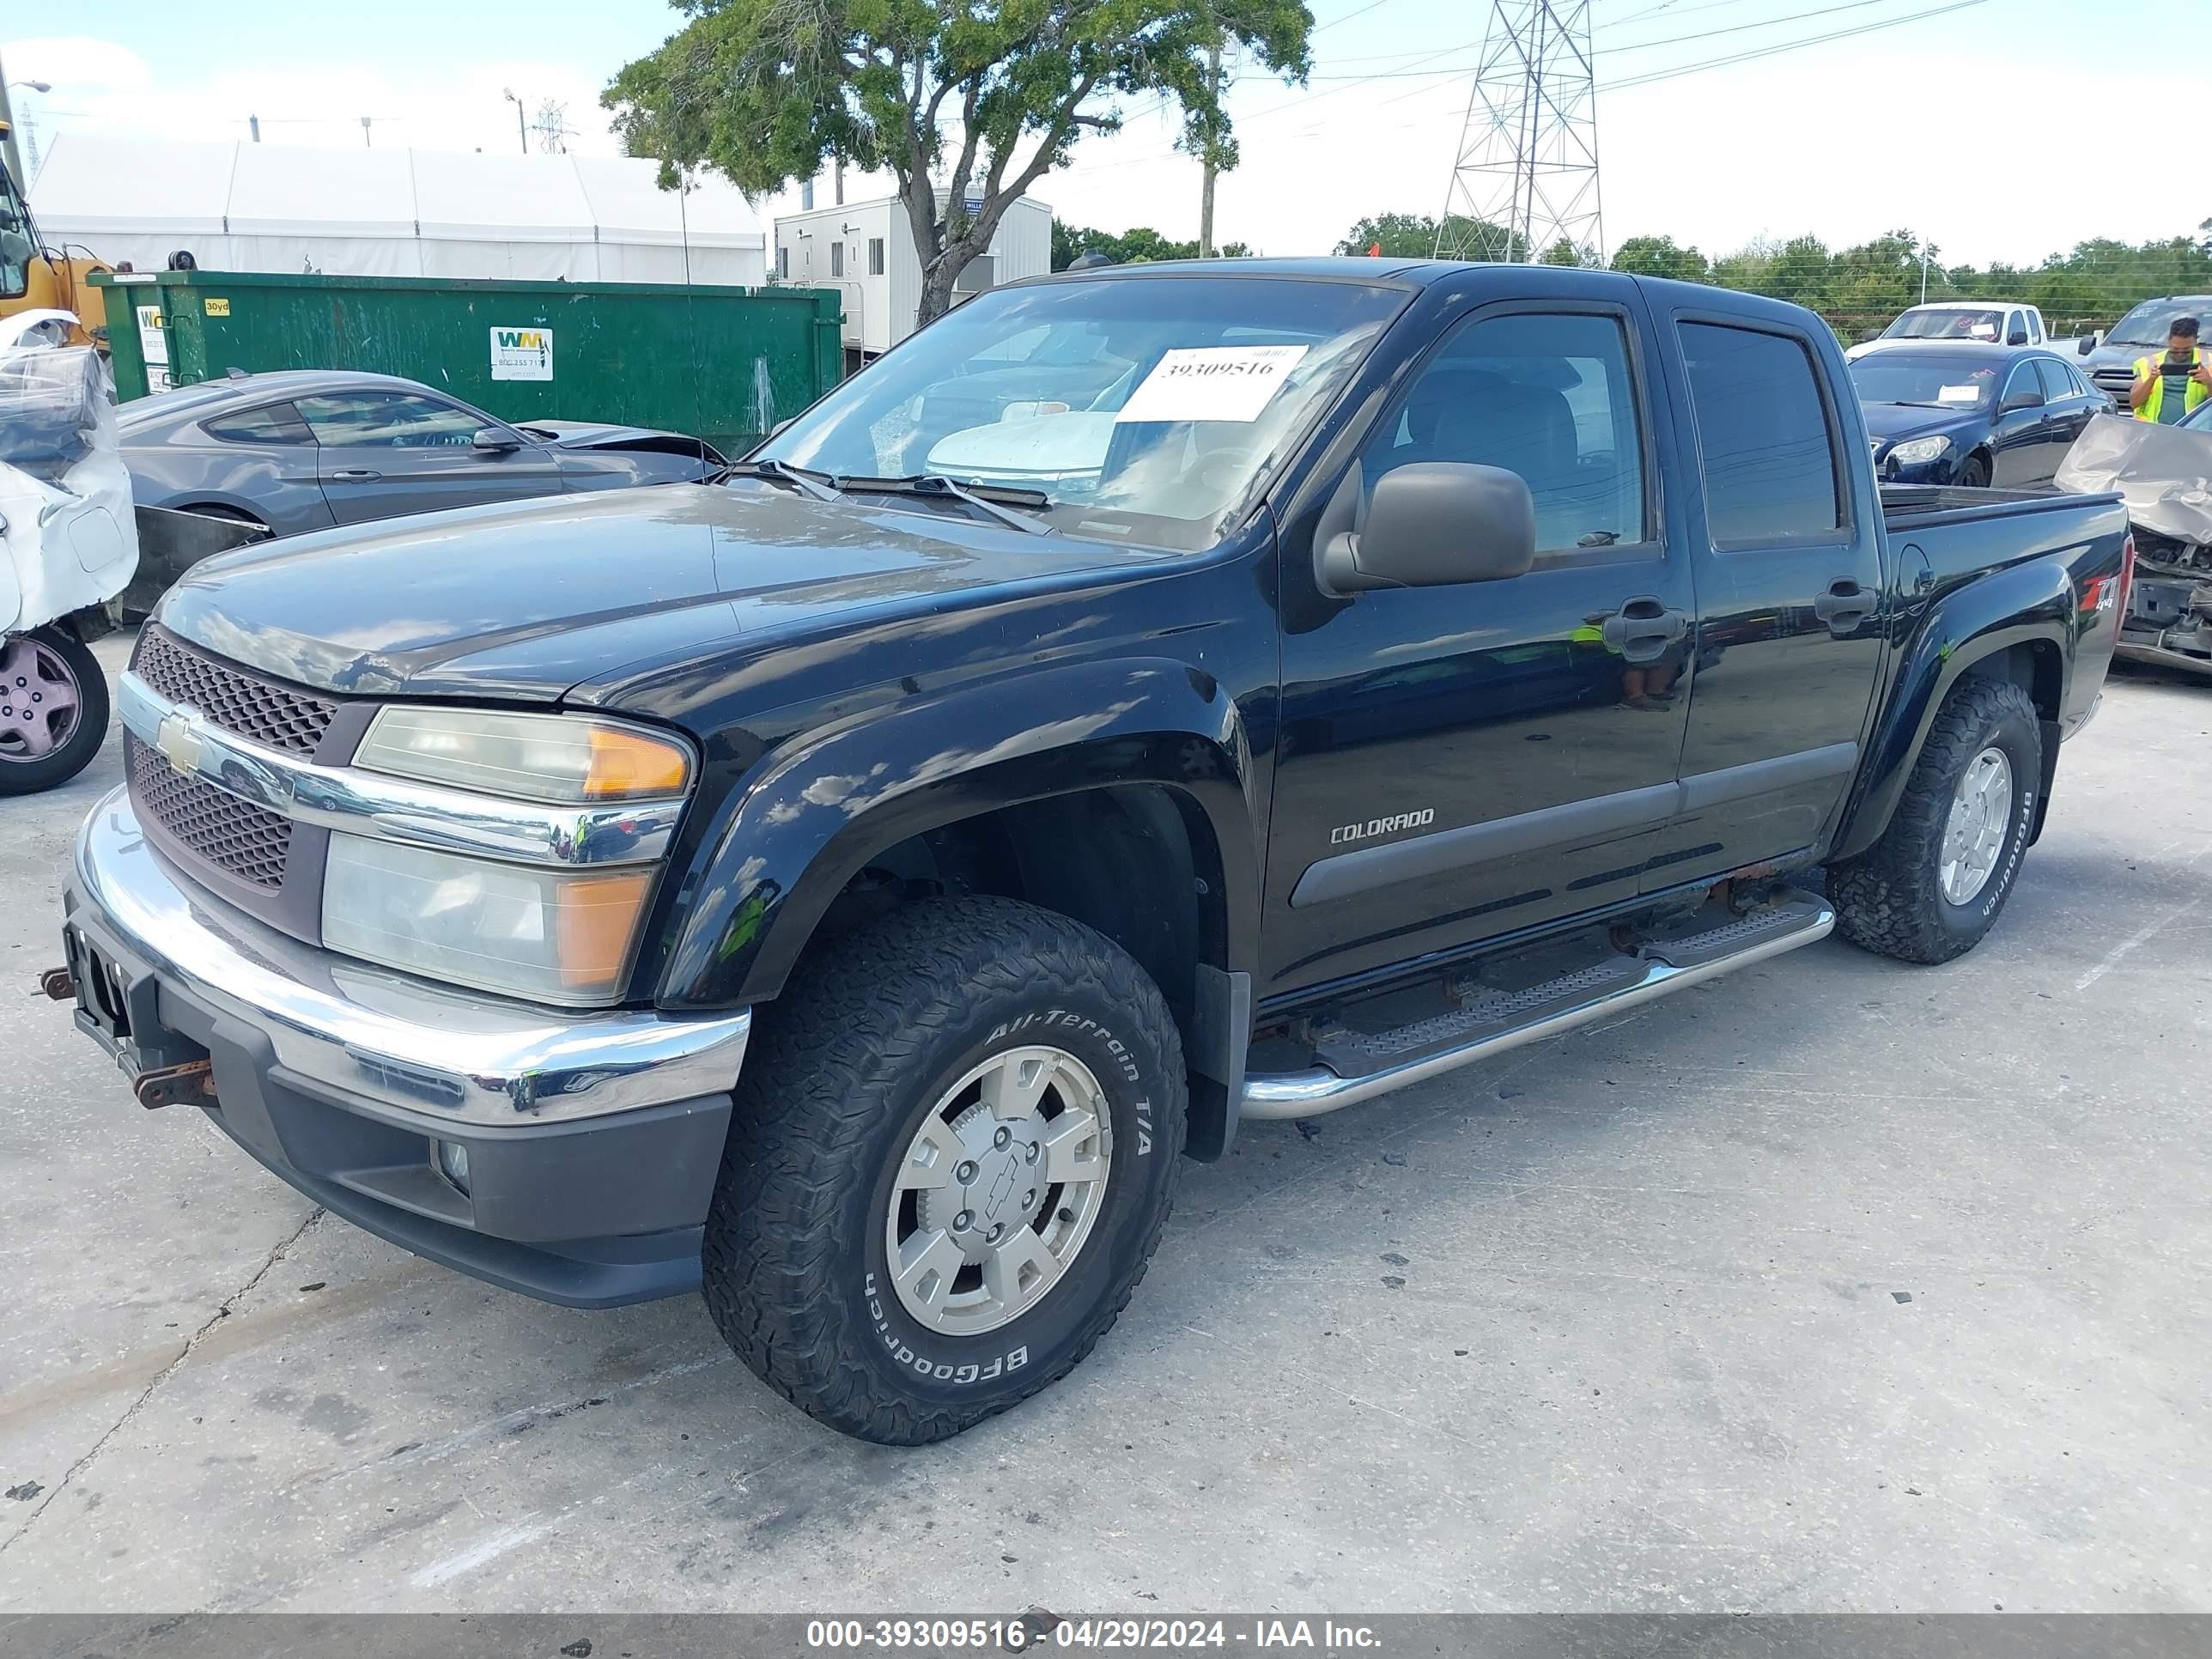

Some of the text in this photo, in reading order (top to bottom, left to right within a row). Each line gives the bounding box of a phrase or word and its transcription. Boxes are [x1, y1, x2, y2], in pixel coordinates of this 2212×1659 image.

[497, 331, 542, 348] WM
[1161, 362, 1273, 378] 39309516
[1330, 808, 1435, 844] COLORADO
[1982, 792, 2033, 917] BFGoodrich
[984, 1009, 1153, 1157] All-Terrain T/A
[864, 1272, 1030, 1384] BFGoodrich
